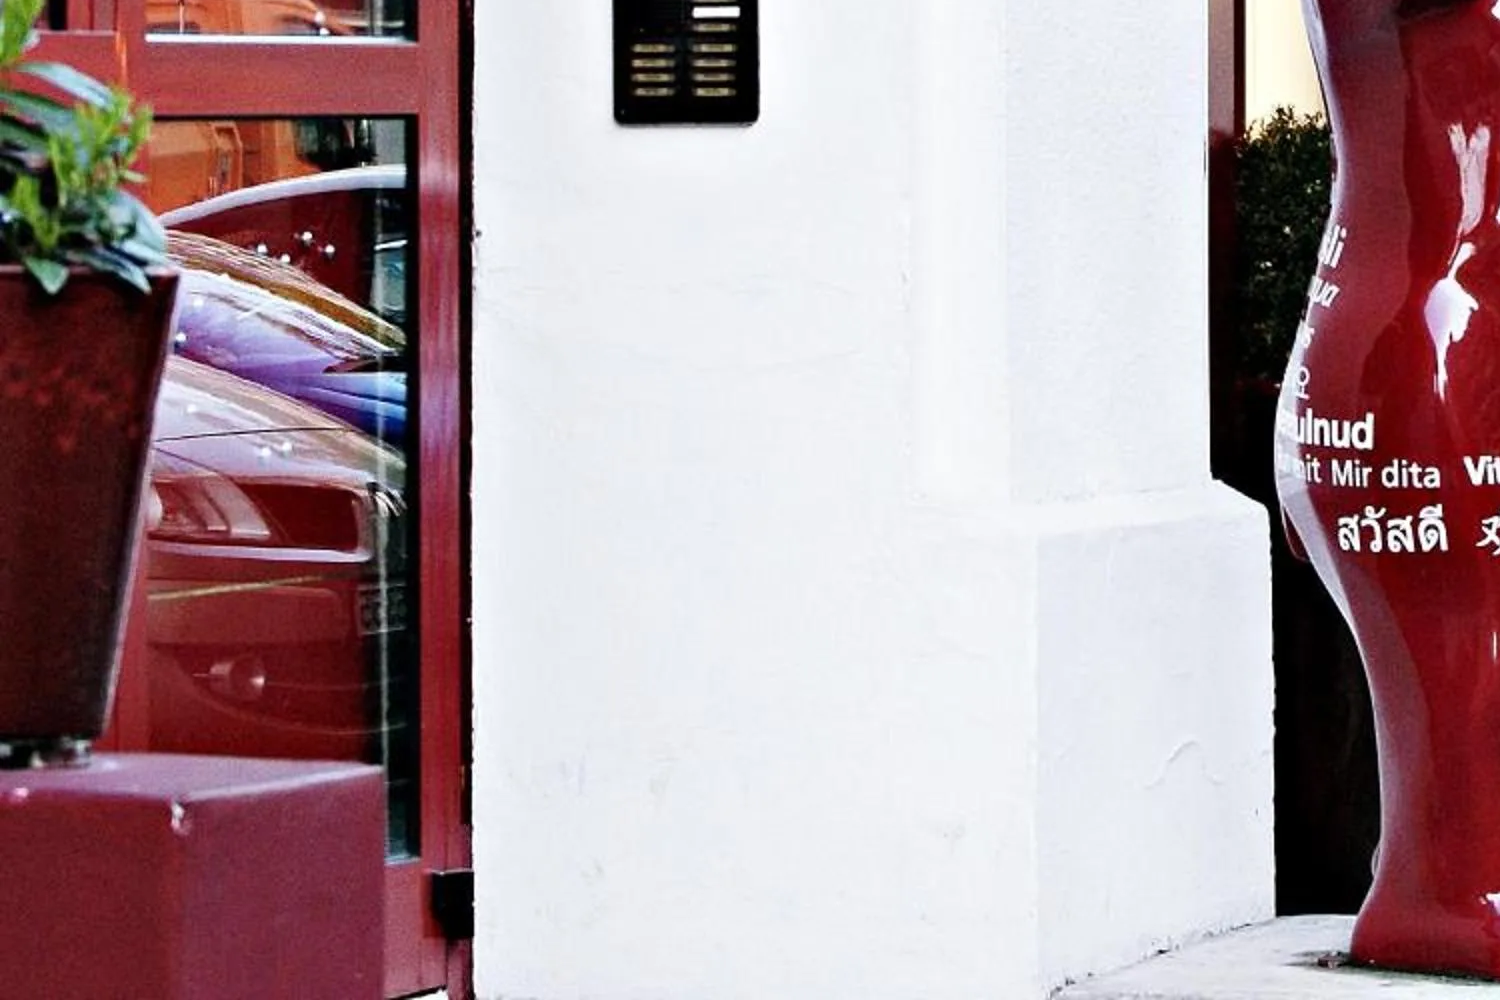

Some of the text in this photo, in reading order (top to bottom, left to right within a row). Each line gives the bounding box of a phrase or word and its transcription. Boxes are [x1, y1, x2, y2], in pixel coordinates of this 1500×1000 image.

[1331, 459, 1373, 489] Mir
[1381, 458, 1441, 489] dita
[1337, 503, 1449, 554] สวัสดี
